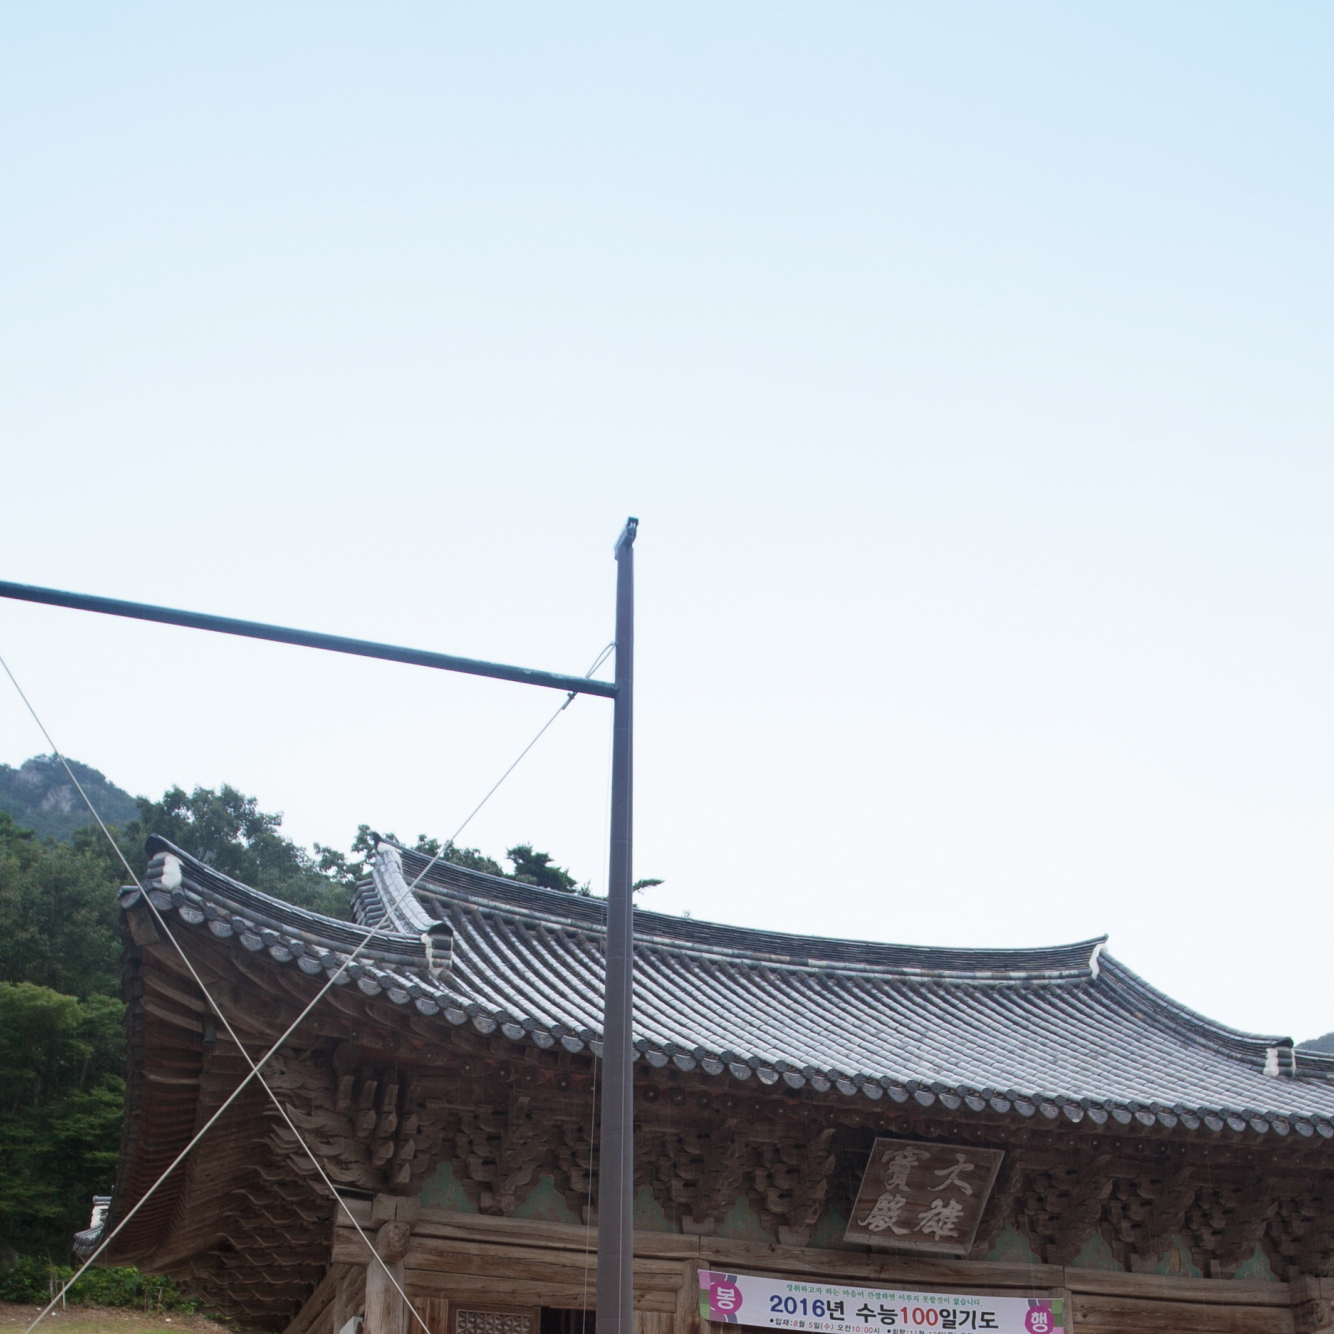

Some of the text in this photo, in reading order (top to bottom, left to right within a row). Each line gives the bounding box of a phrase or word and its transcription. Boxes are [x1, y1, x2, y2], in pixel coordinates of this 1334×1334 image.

[716, 1286, 736, 1310] 봉
[825, 1287, 840, 1297] 하는
[842, 1289, 865, 1299] 마음이
[898, 1294, 920, 1303] 이루지
[769, 1294, 845, 1321] 2016년
[837, 1324, 880, 1334] 오전10:00시
[1030, 1311, 1049, 1333] 행
